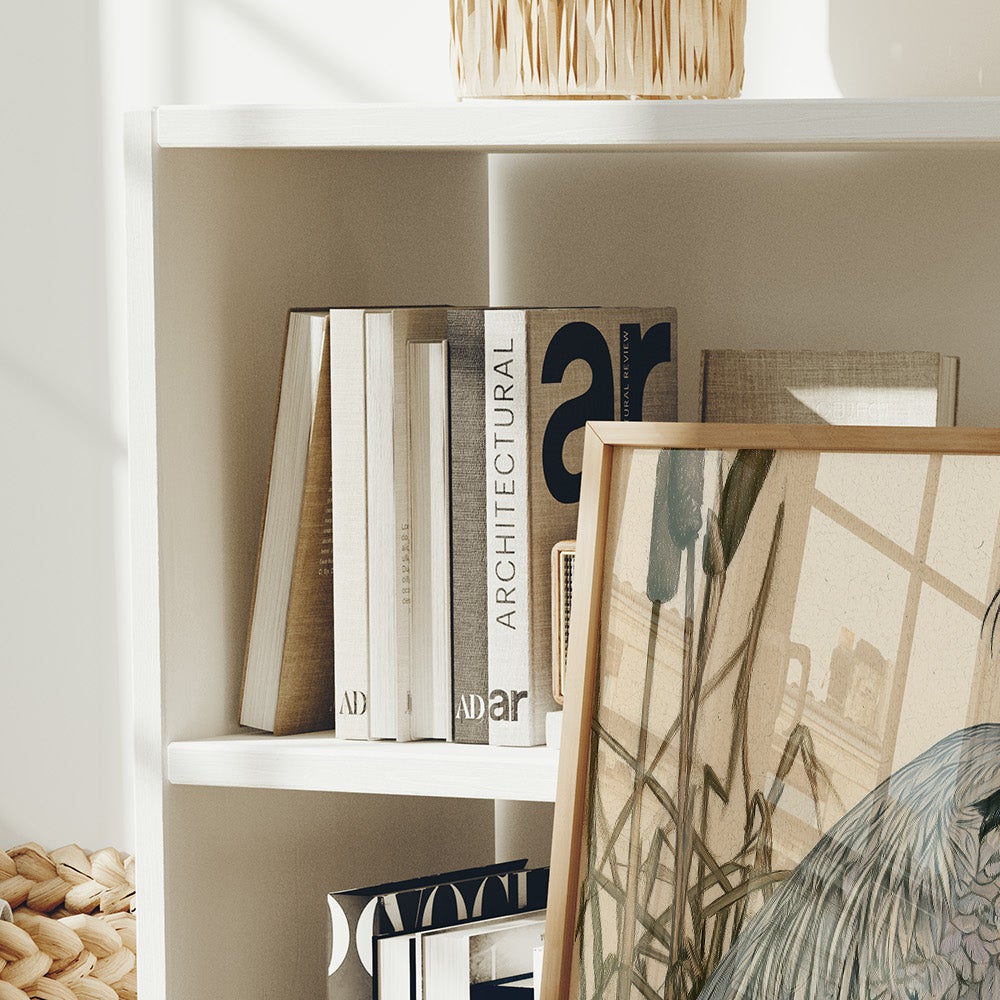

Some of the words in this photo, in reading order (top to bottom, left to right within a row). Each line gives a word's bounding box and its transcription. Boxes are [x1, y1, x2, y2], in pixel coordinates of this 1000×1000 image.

[622, 330, 631, 379] REVIEW
[622, 383, 631, 421] URAL
[493, 338, 516, 630] ARCHITECTURAL
[339, 690, 367, 716] AD
[456, 694, 486, 720] AD
[489, 688, 528, 722] ar
